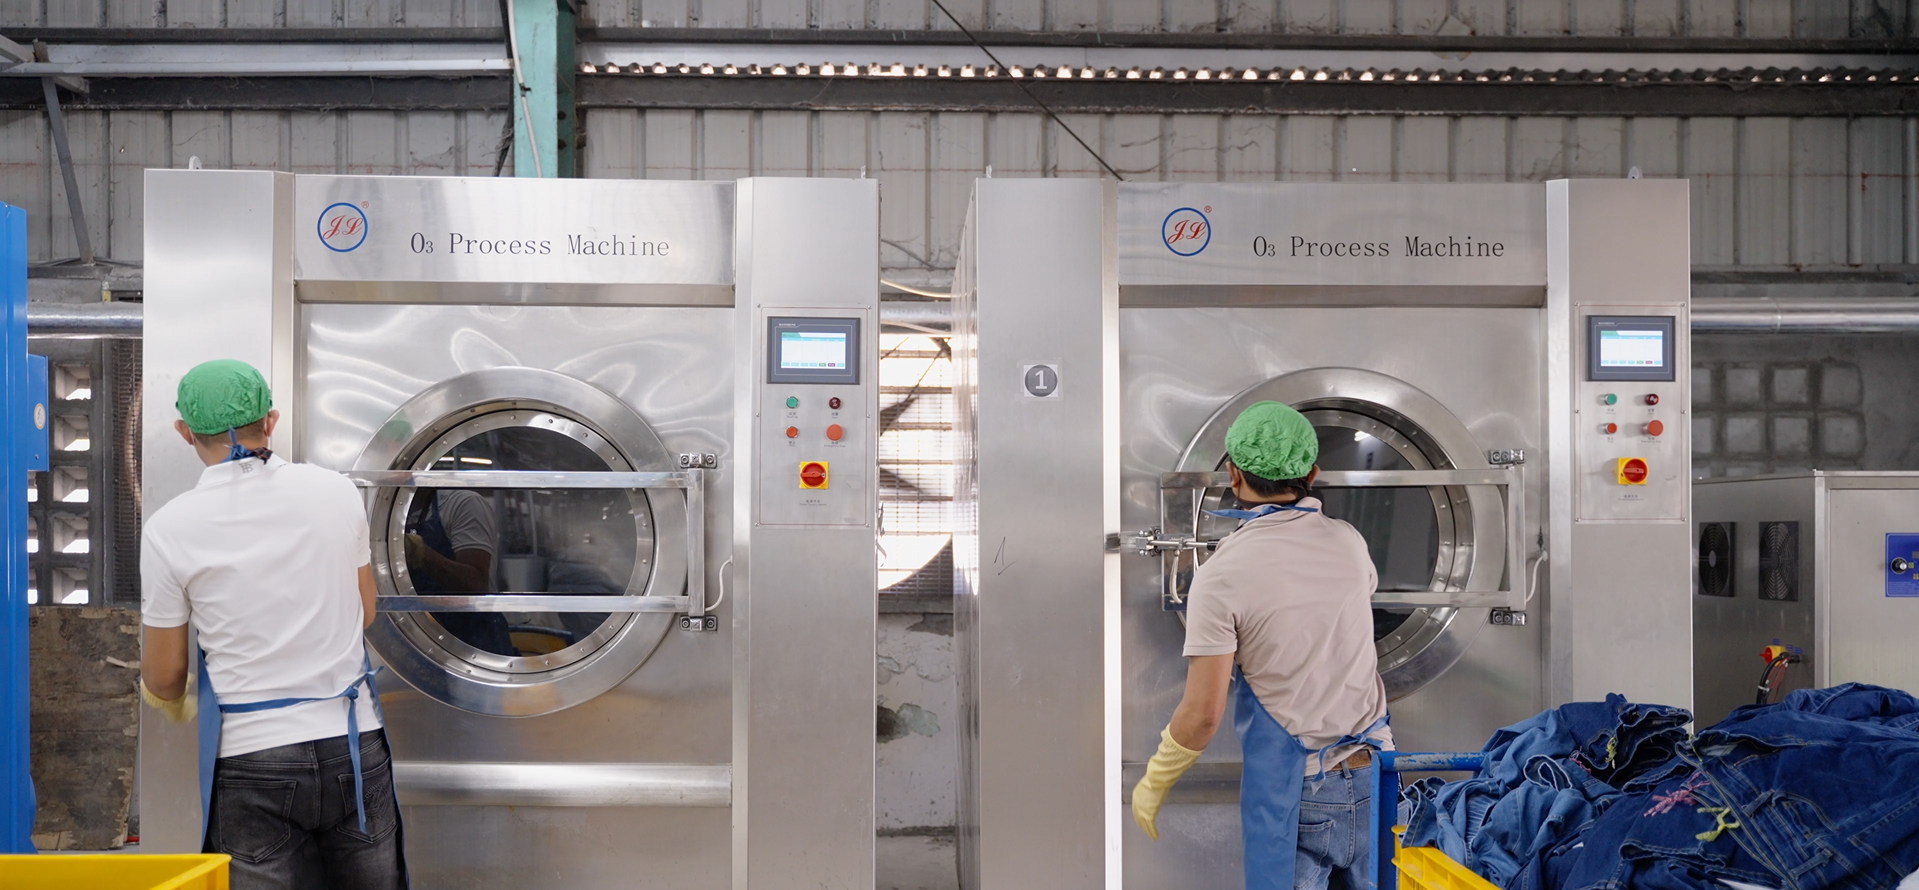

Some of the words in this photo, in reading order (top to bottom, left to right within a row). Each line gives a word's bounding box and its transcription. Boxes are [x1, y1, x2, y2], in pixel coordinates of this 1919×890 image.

[322, 215, 363, 239] JL
[1166, 219, 1207, 244] JL
[448, 232, 552, 255] Process
[567, 234, 670, 256] Machine
[1290, 236, 1390, 257] Process
[1404, 236, 1505, 257] Machine
[1035, 370, 1048, 390] 1
